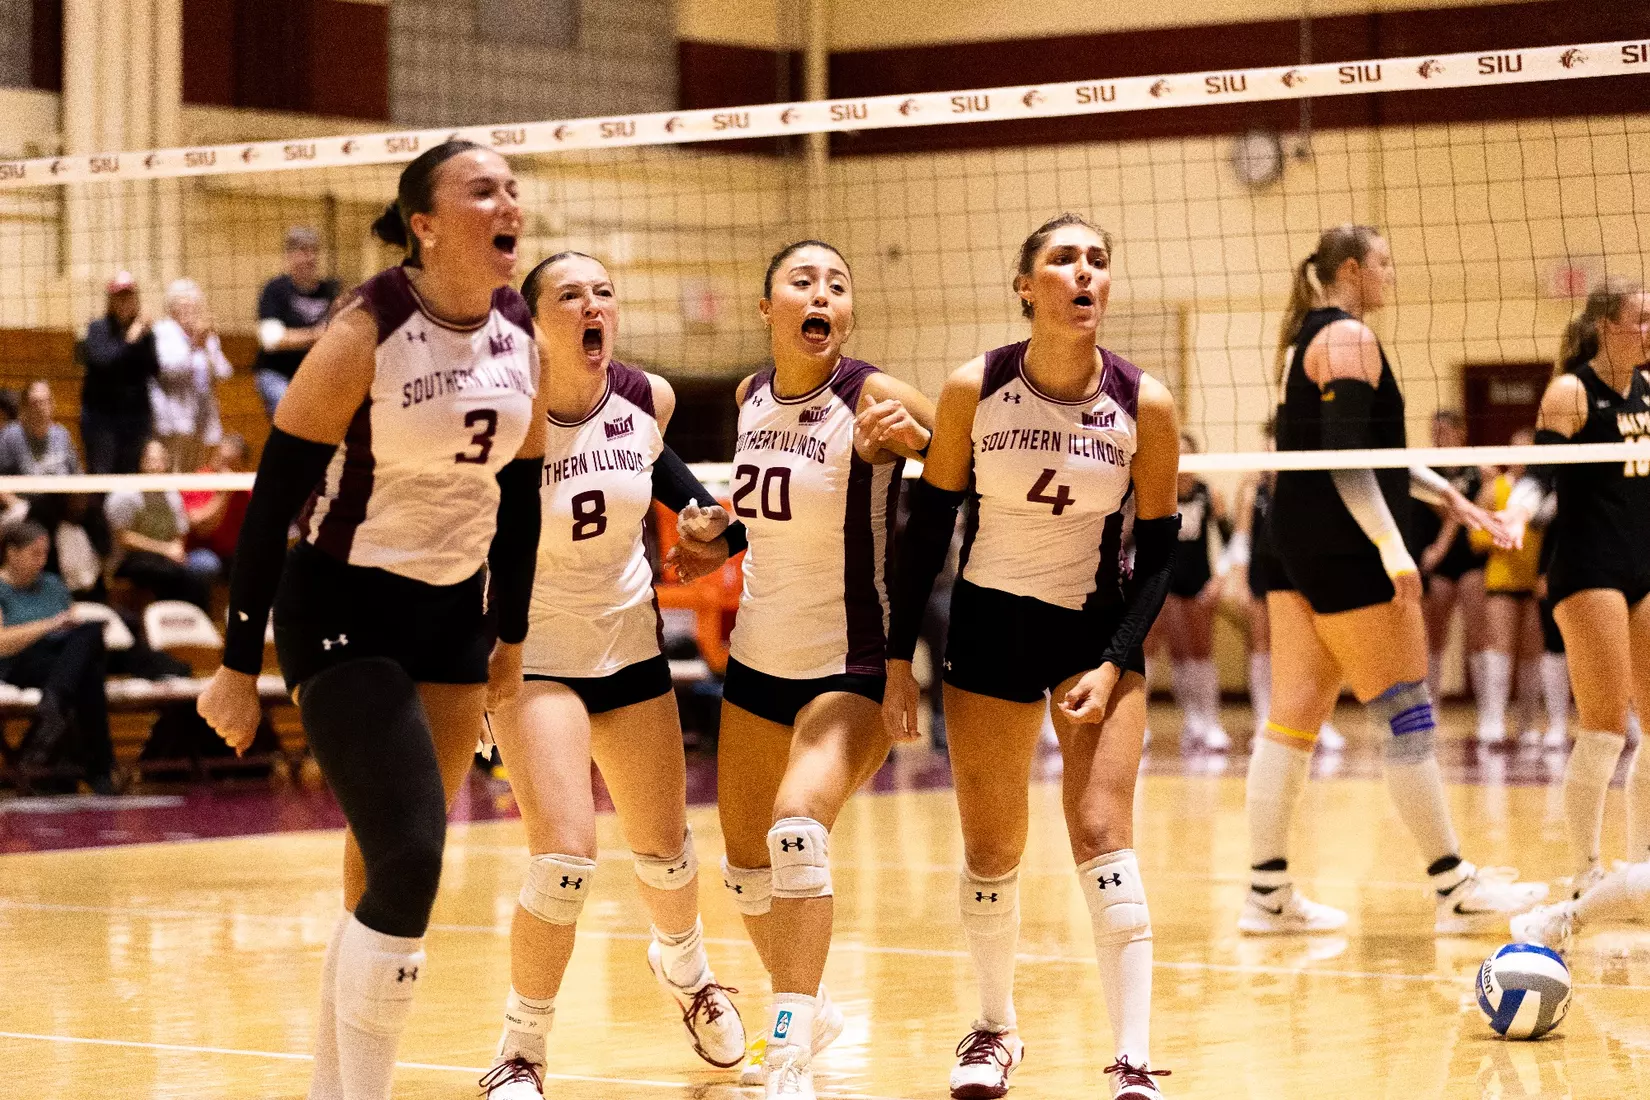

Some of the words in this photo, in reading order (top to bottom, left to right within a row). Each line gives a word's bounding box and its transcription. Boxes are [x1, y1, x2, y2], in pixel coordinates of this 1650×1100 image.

[89, 154, 119, 173] SIU
[184, 150, 216, 168] SIU
[283, 144, 316, 162] SIU
[385, 136, 419, 154] SIU
[491, 128, 526, 147] SIU
[599, 120, 636, 139] SIU
[712, 112, 749, 131] SIU
[830, 103, 868, 121] SIU
[950, 95, 990, 114] SIU
[1076, 85, 1116, 104] SIU
[1205, 73, 1247, 94] SIU
[1338, 64, 1382, 85] SIU
[1478, 54, 1522, 75] SIU
[1621, 44, 1650, 65] SI
[455, 408, 498, 464] 3
[604, 413, 635, 439] VALLEY
[779, 431, 827, 464] ILLINOIS
[981, 428, 1062, 453] SOUTHERN
[1068, 433, 1126, 467] ILLINOIS
[543, 452, 589, 486] THERN
[592, 449, 644, 472] ILLINOIS
[733, 464, 792, 521] 20
[1027, 468, 1076, 516] 4
[572, 490, 608, 541] 8
[1484, 957, 1495, 996] olten
